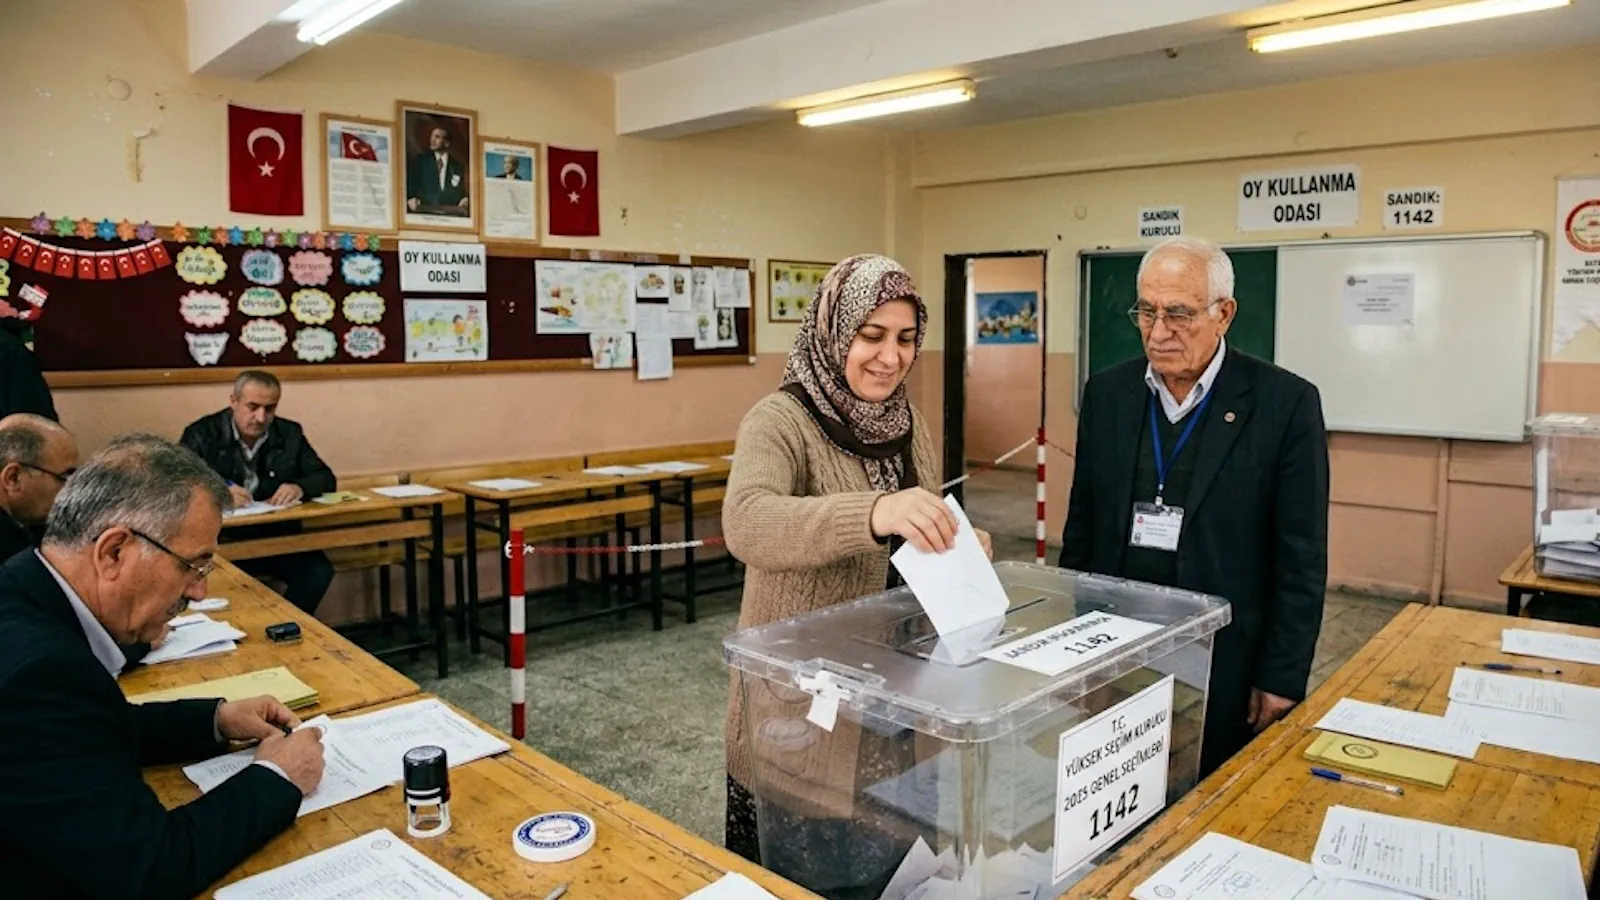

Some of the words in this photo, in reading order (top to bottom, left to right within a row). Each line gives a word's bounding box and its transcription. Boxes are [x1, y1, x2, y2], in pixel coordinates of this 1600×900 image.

[1242, 180, 1264, 199] OY
[1267, 172, 1357, 197] KULLANMA
[1387, 191, 1441, 206] SANDIK:
[1273, 202, 1321, 223] ODASI
[1393, 210, 1434, 225] 1142
[403, 251, 420, 264] OY
[422, 252, 482, 266] KULLANMA
[427, 270, 461, 284] ODASI
[1088, 783, 1140, 841] 1142
